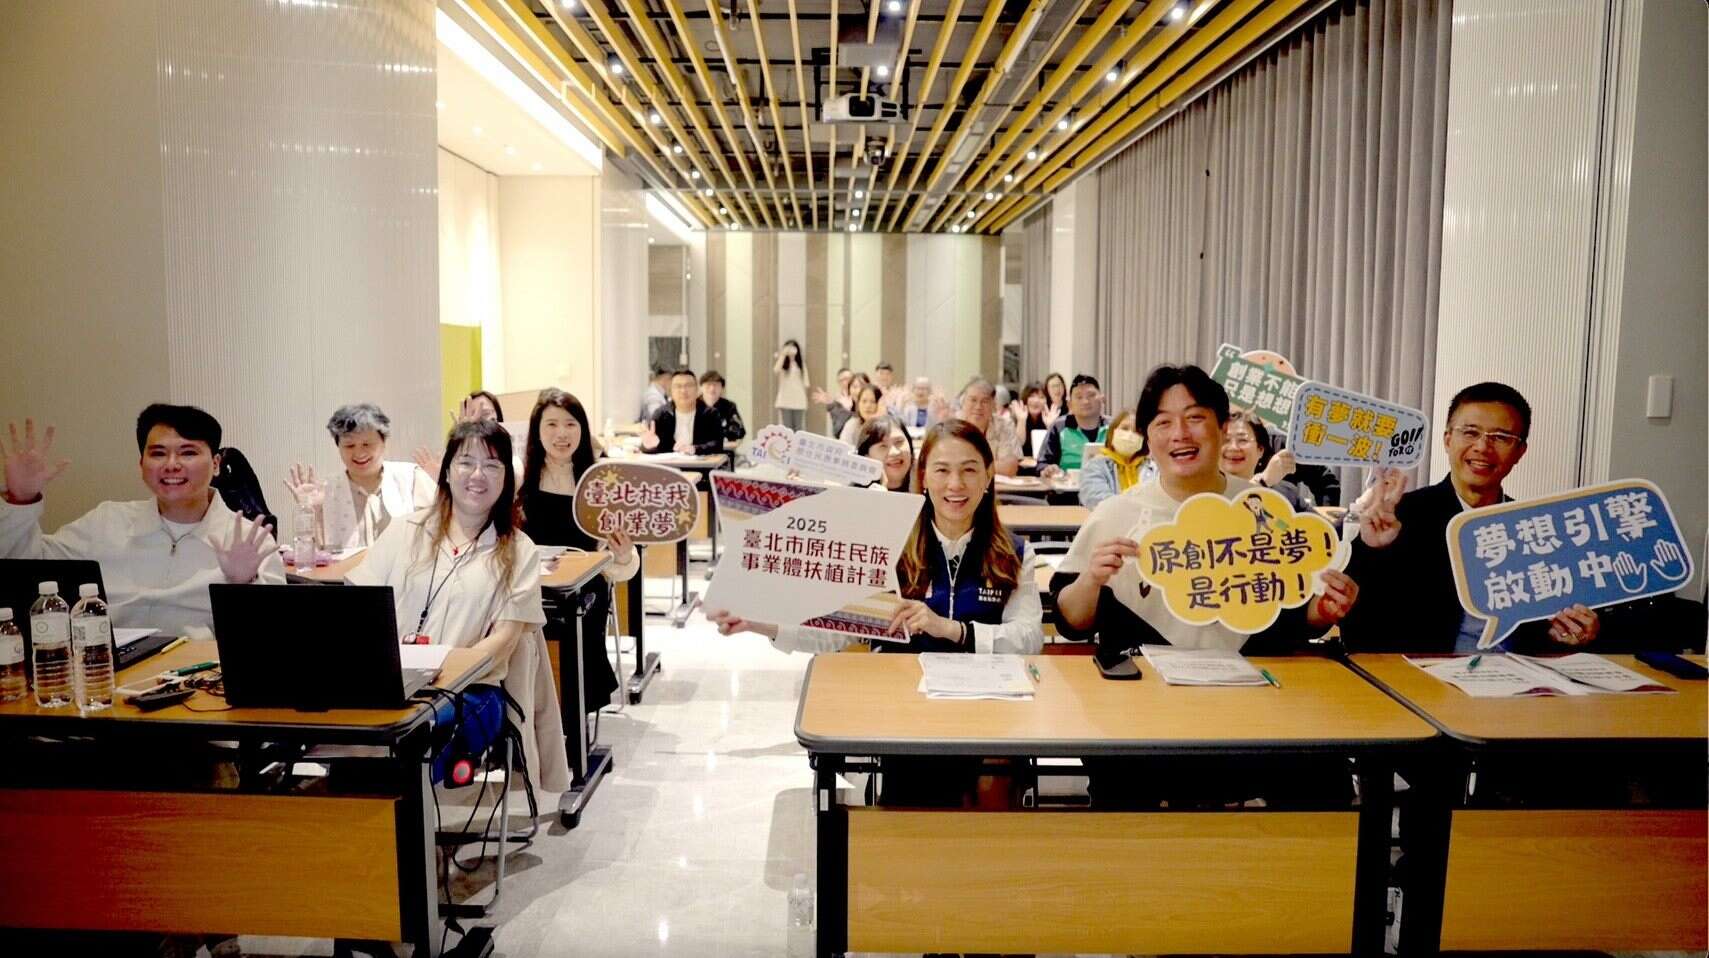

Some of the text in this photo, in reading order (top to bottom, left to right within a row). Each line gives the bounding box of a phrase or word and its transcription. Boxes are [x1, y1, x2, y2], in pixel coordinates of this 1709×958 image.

[1304, 394, 1399, 439] 有夢就要
[585, 480, 689, 508] 臺北挺我
[598, 509, 676, 537] 創業夢
[786, 516, 828, 534] 2025
[1473, 492, 1658, 568] 夢想引擎
[743, 528, 890, 567] 臺北市原住民族
[741, 551, 888, 588] 事業體扶植計畫
[1484, 551, 1613, 611] 啟動中
